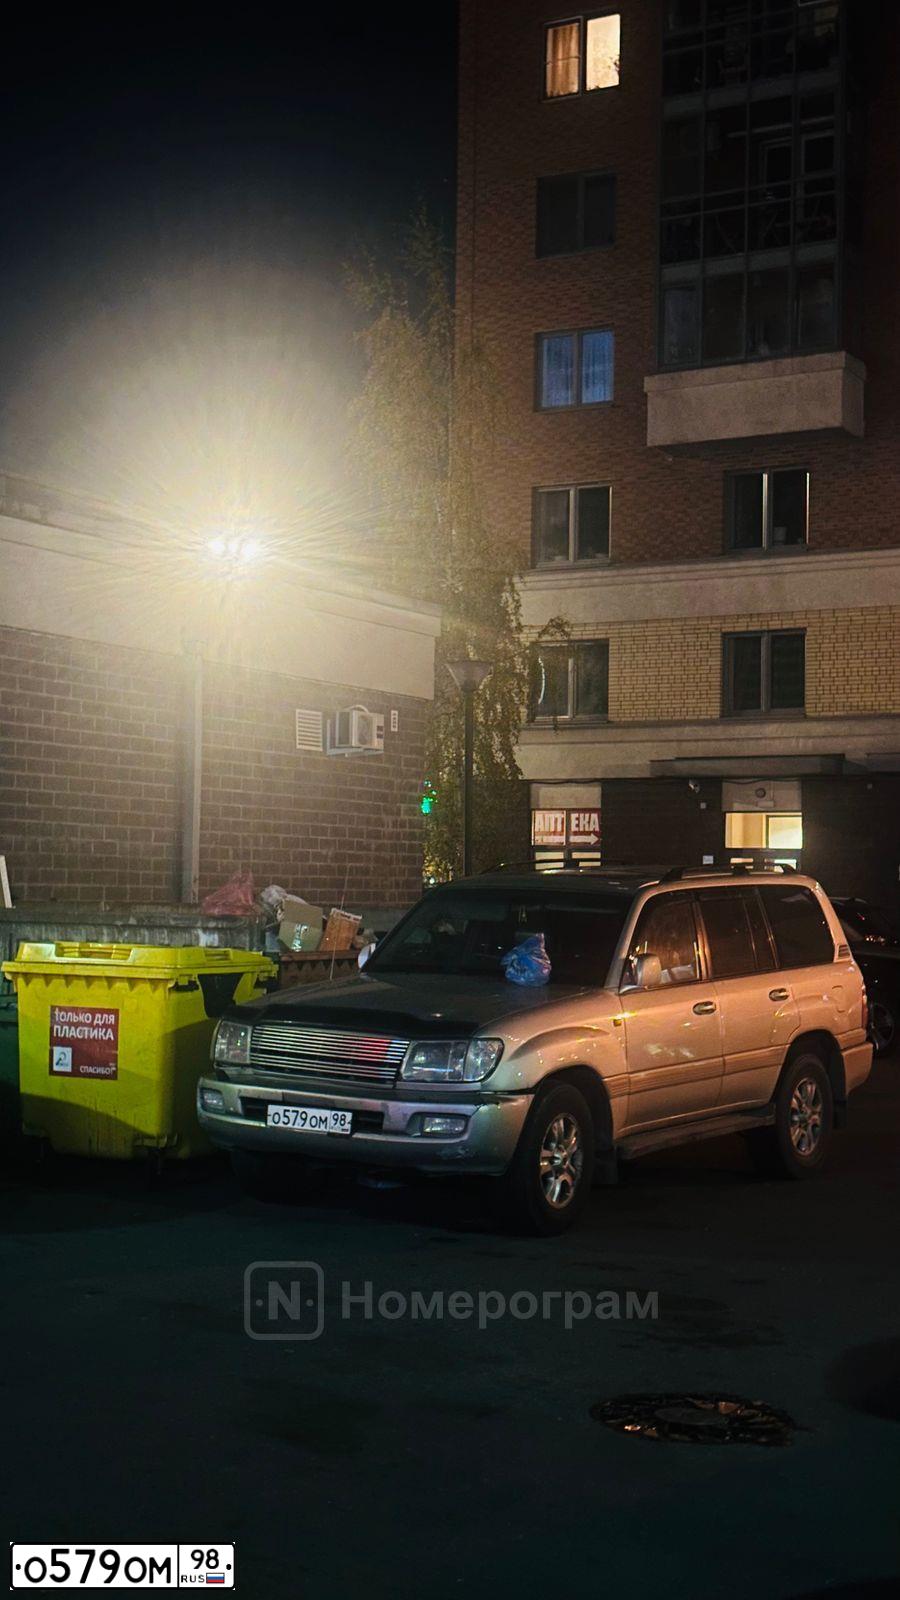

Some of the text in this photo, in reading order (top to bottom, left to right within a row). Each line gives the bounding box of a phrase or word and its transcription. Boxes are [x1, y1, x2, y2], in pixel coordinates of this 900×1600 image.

[93, 1013, 115, 1026] ДЛЯ
[53, 1024, 114, 1041] ПЛАСТИКА
[332, 1113, 347, 1127] 98
